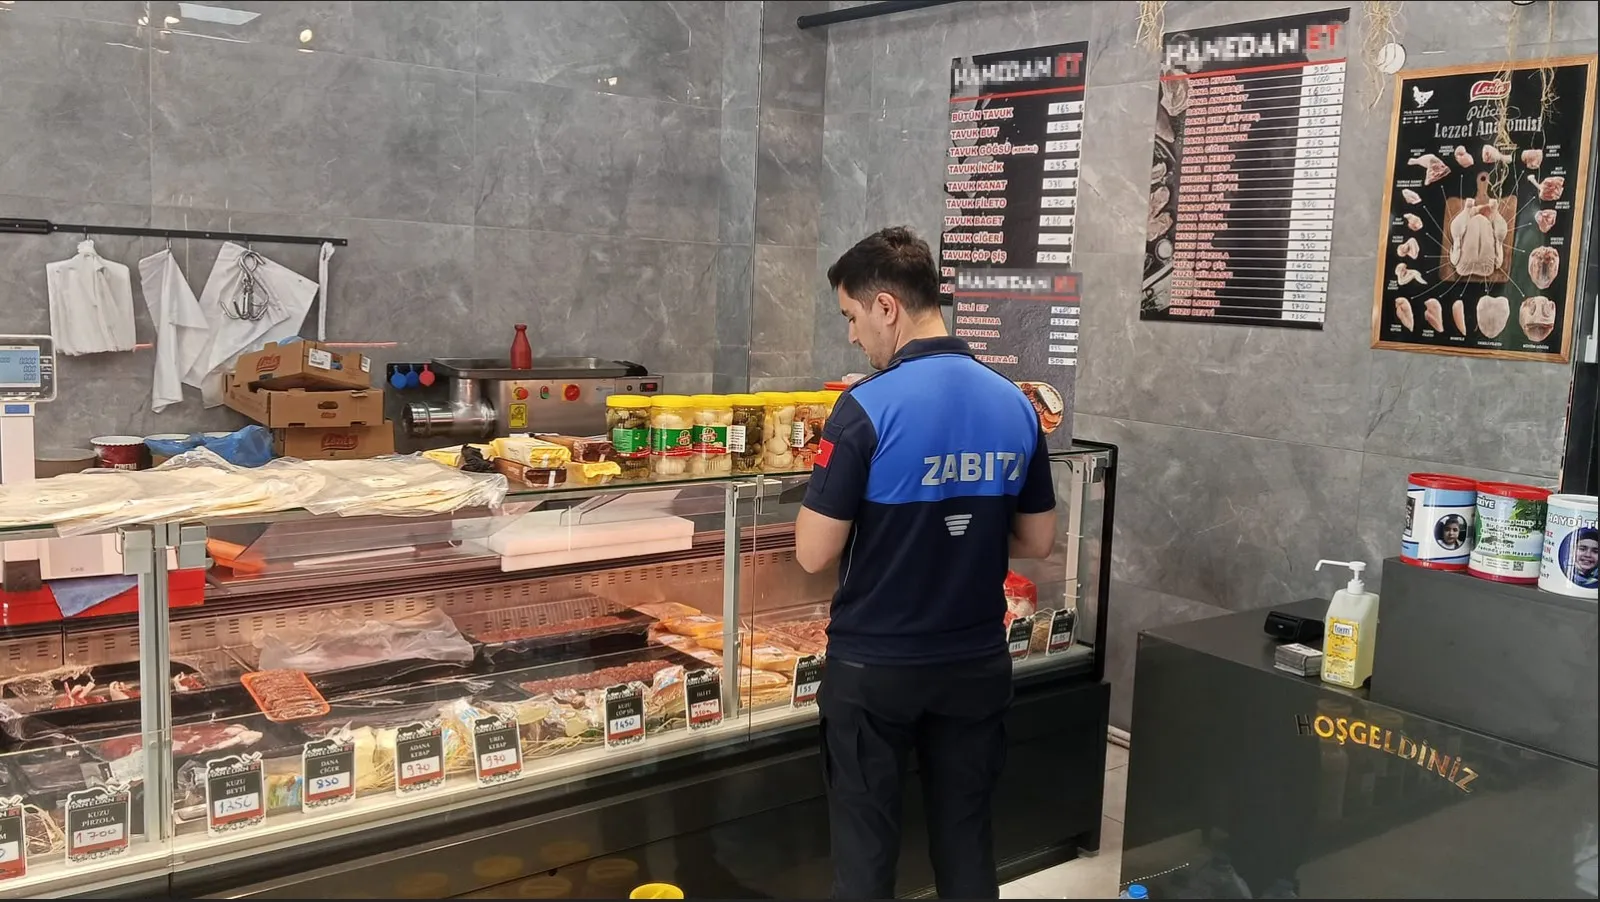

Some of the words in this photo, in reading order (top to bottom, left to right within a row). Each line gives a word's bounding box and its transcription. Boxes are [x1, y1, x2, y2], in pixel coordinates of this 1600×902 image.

[952, 111, 981, 122] BÜTÜN
[983, 108, 1014, 119] TAVUK
[1434, 120, 1473, 138] Lezzet
[1476, 116, 1541, 136] Anaomisi
[951, 129, 979, 139] TAVUK
[980, 127, 999, 137] BUT
[950, 146, 978, 157] TAVUK
[979, 143, 1011, 155] GÖĞSÜ
[949, 165, 977, 175] TAVUK
[978, 162, 1004, 173] İNCİK
[947, 182, 976, 192] TAVUK
[977, 180, 1007, 191] KANAT
[946, 199, 975, 209] TAVUK
[975, 197, 1007, 208] FİLETO
[945, 217, 974, 226] TAVUK
[974, 216, 1004, 225] BAGET
[944, 234, 973, 243] TAVUK
[973, 232, 1003, 244] CİĞERİ
[943, 251, 971, 260] TAVUK
[972, 250, 991, 262] ÇÖP
[991, 250, 1007, 263] ŞİŞ
[957, 316, 1001, 325] PASTIRMA
[956, 329, 1000, 337] KAVURMA
[615, 718, 635, 730] 1450
[410, 743, 430, 751] ADANA
[411, 750, 430, 758] KEBAP
[321, 759, 339, 767] DANA
[320, 766, 340, 774] CİĞER
[226, 779, 246, 787] KUZU
[226, 786, 246, 795] BEYTİ
[88, 809, 110, 818] KUZU
[82, 816, 115, 827] PİRZOLA
